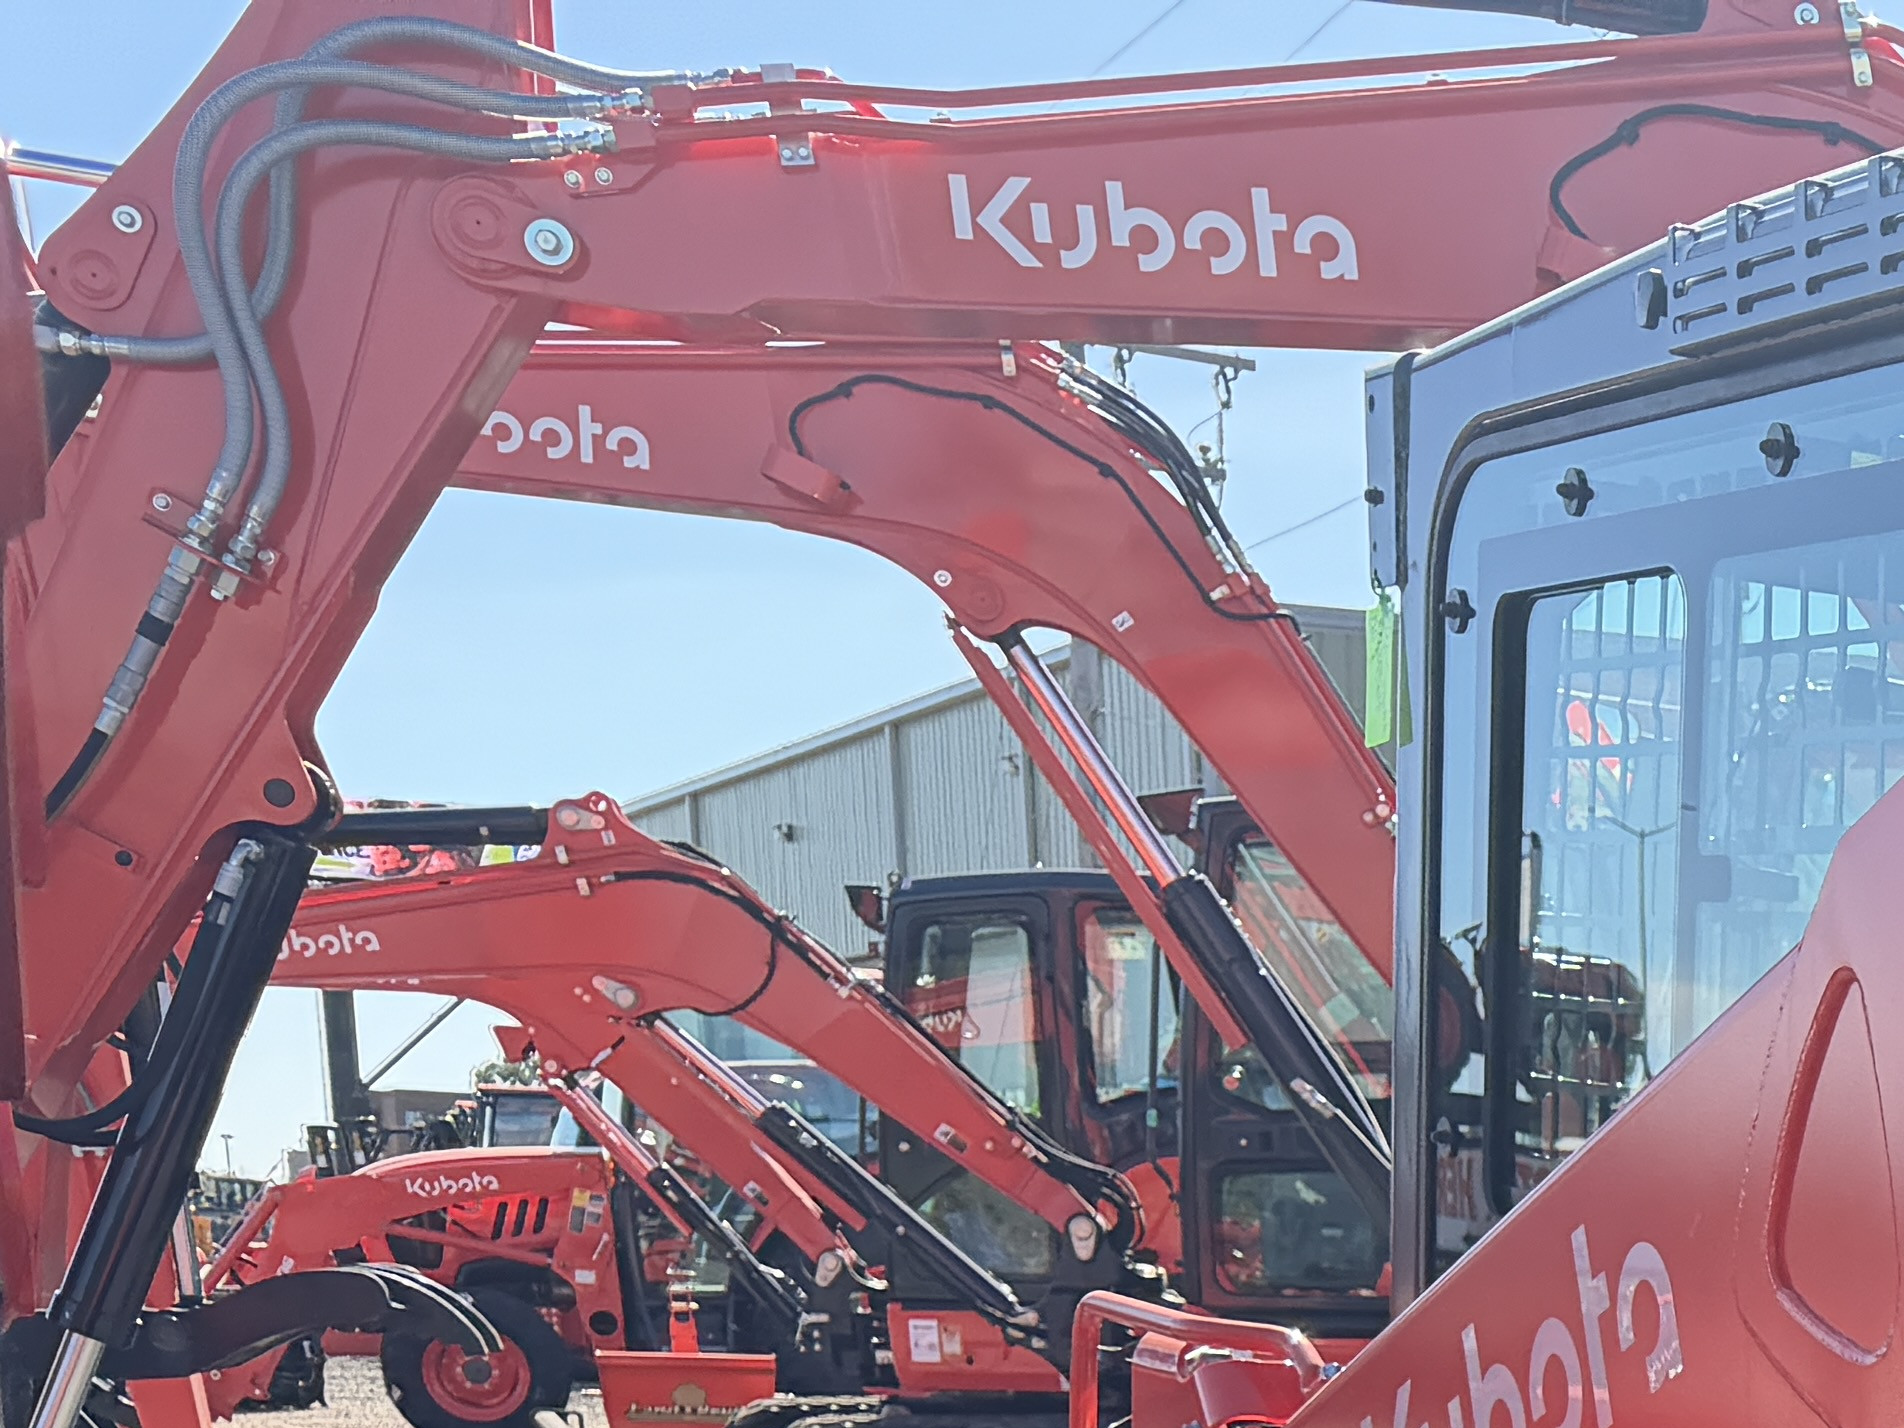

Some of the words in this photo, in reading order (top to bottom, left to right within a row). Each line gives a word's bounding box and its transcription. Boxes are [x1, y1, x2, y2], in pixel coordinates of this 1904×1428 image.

[948, 173, 1359, 280] Kubota
[480, 404, 650, 470] bota
[277, 924, 381, 961] ubota
[405, 1171, 499, 1198] Kubota
